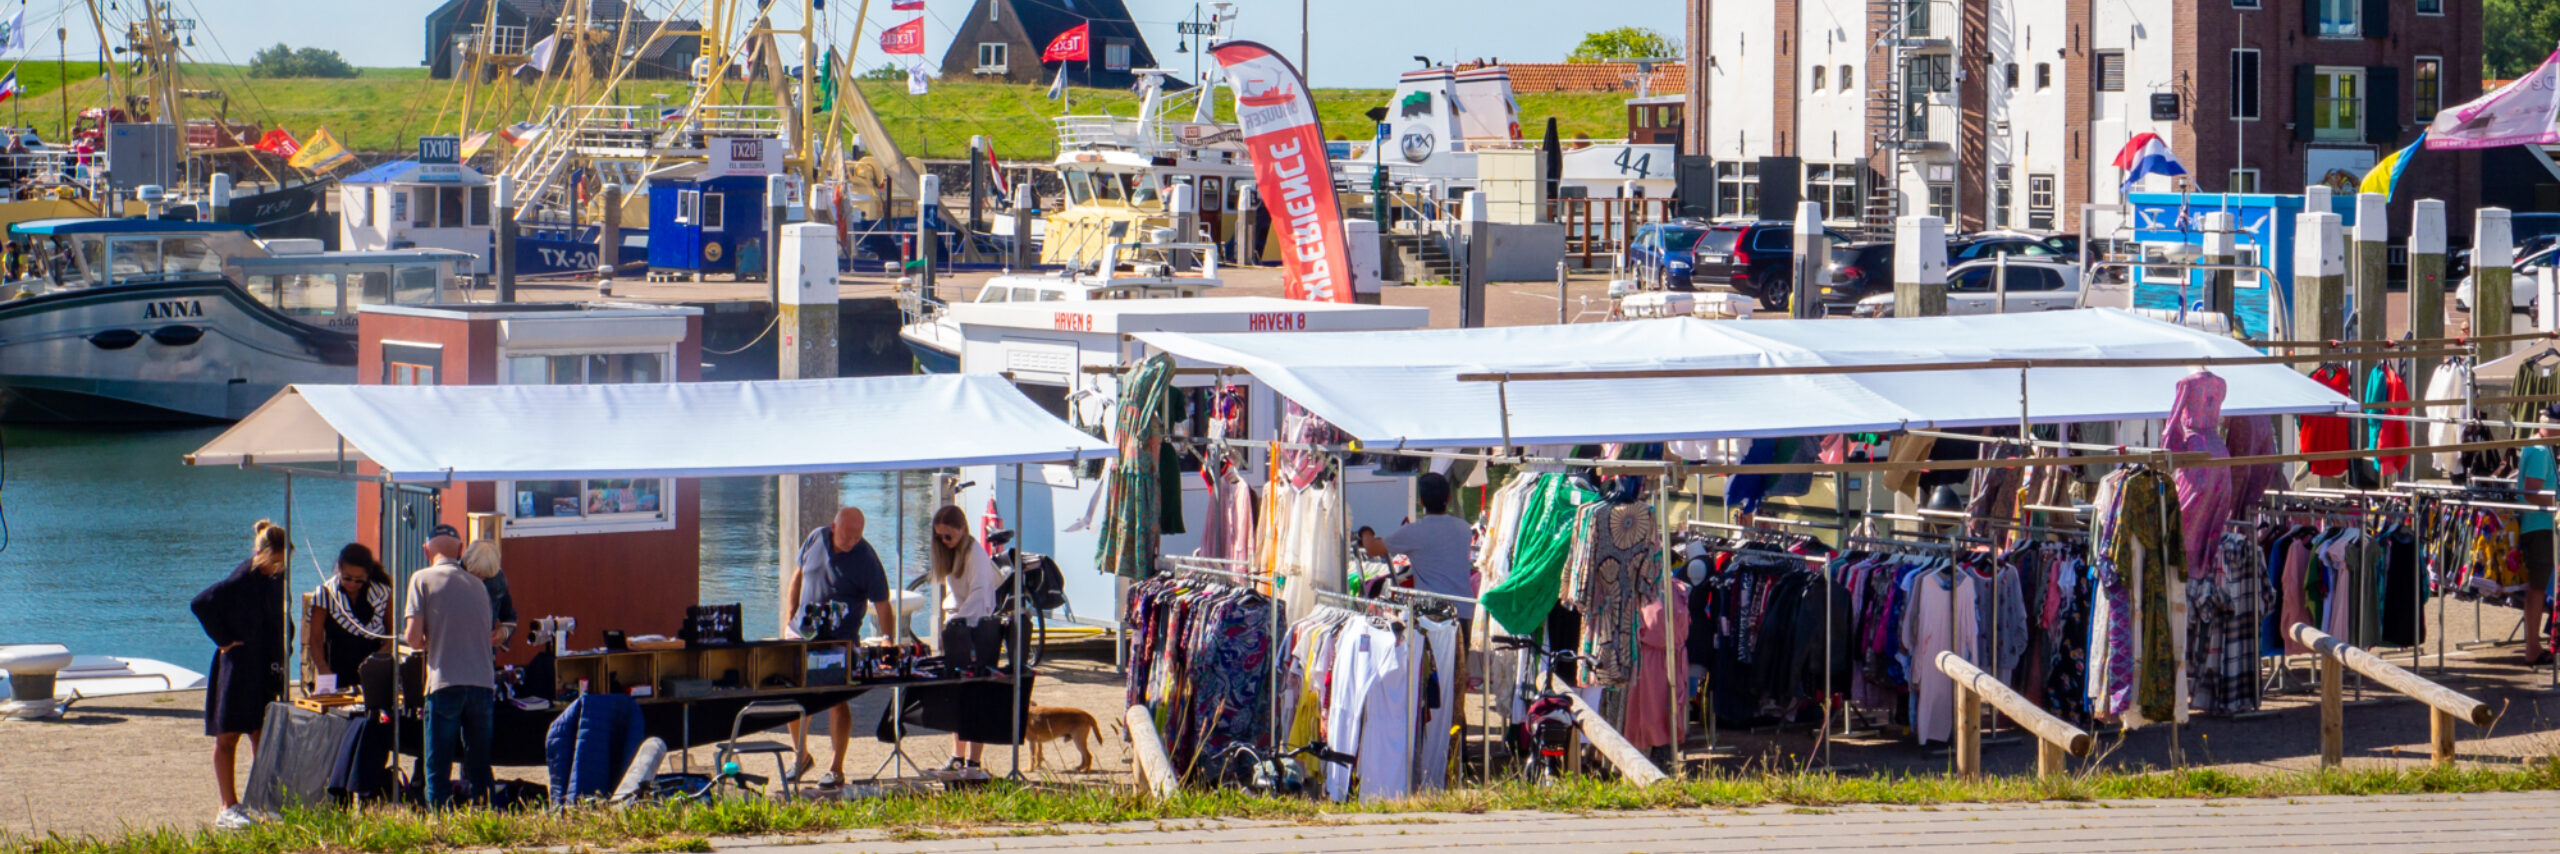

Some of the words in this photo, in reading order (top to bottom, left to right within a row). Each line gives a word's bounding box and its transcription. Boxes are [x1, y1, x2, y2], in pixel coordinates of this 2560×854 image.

[420, 140, 451, 158] TX10
[732, 142, 757, 158] TX20
[1614, 146, 1651, 179] 44
[538, 247, 599, 269] TX-20
[143, 300, 204, 319] ANNA
[1054, 311, 1084, 331] HAVEN
[1086, 313, 1093, 331] 8
[1249, 312, 1293, 331] HAVEN
[1297, 312, 1306, 331] 8
